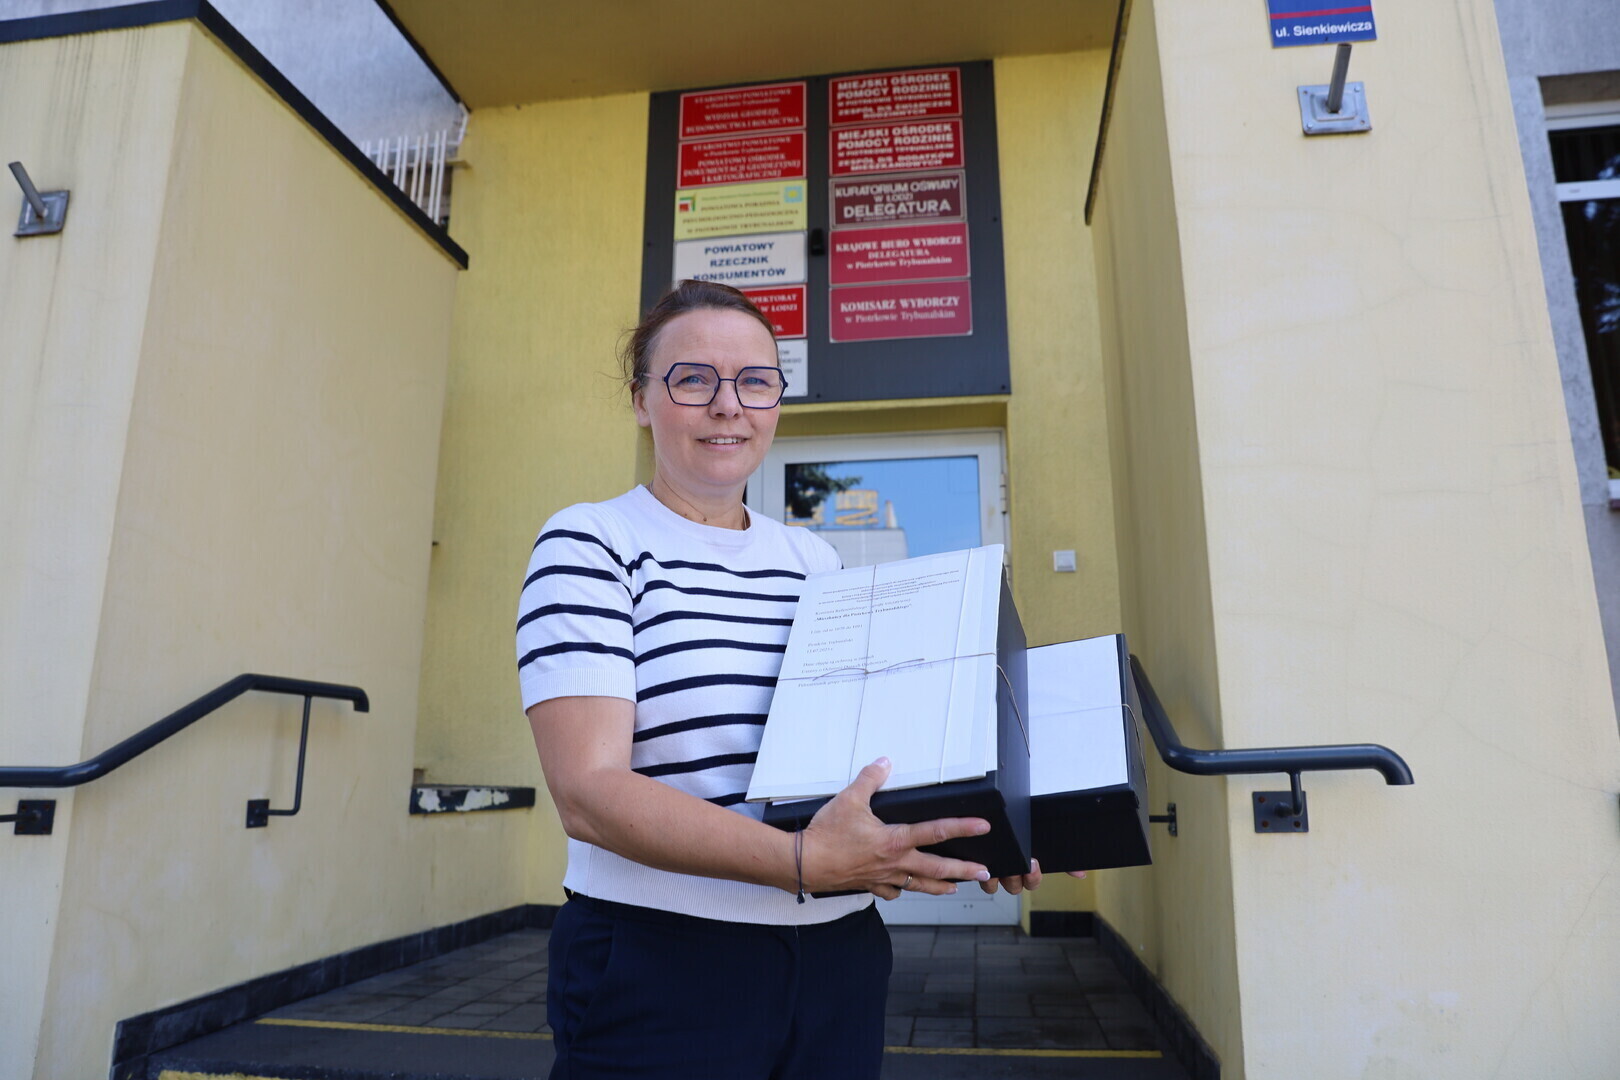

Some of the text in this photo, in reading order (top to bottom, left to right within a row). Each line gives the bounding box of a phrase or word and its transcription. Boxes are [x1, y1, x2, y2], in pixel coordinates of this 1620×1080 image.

[1275, 21, 1373, 38] ul. Sienkiewicza
[837, 72, 950, 90] MIEJSKI OŚRODEK
[837, 81, 951, 100] POMOCY RODZINIE
[838, 123, 952, 141] MIEJSKI OŚRODEK
[837, 133, 953, 150] POMOCY RODZINIE
[835, 183, 909, 198] KURATORIUM
[873, 194, 883, 202] W
[843, 199, 952, 218] DELEGATURA
[704, 242, 774, 255] POWIATOWY
[836, 236, 962, 253] KRAJOWE BIURO WYBORCZE
[710, 256, 769, 268] RZECZNIK
[868, 249, 930, 260] DELEGATURA
[855, 259, 897, 269] Piotrkowie
[898, 257, 953, 268] Trybunalskim
[693, 267, 786, 281] KONSUMENTÓW
[840, 296, 960, 313] KOMISARZ WYBORCZY
[855, 313, 898, 323] Piotrkowie
[901, 310, 956, 322] Trybunalskim
